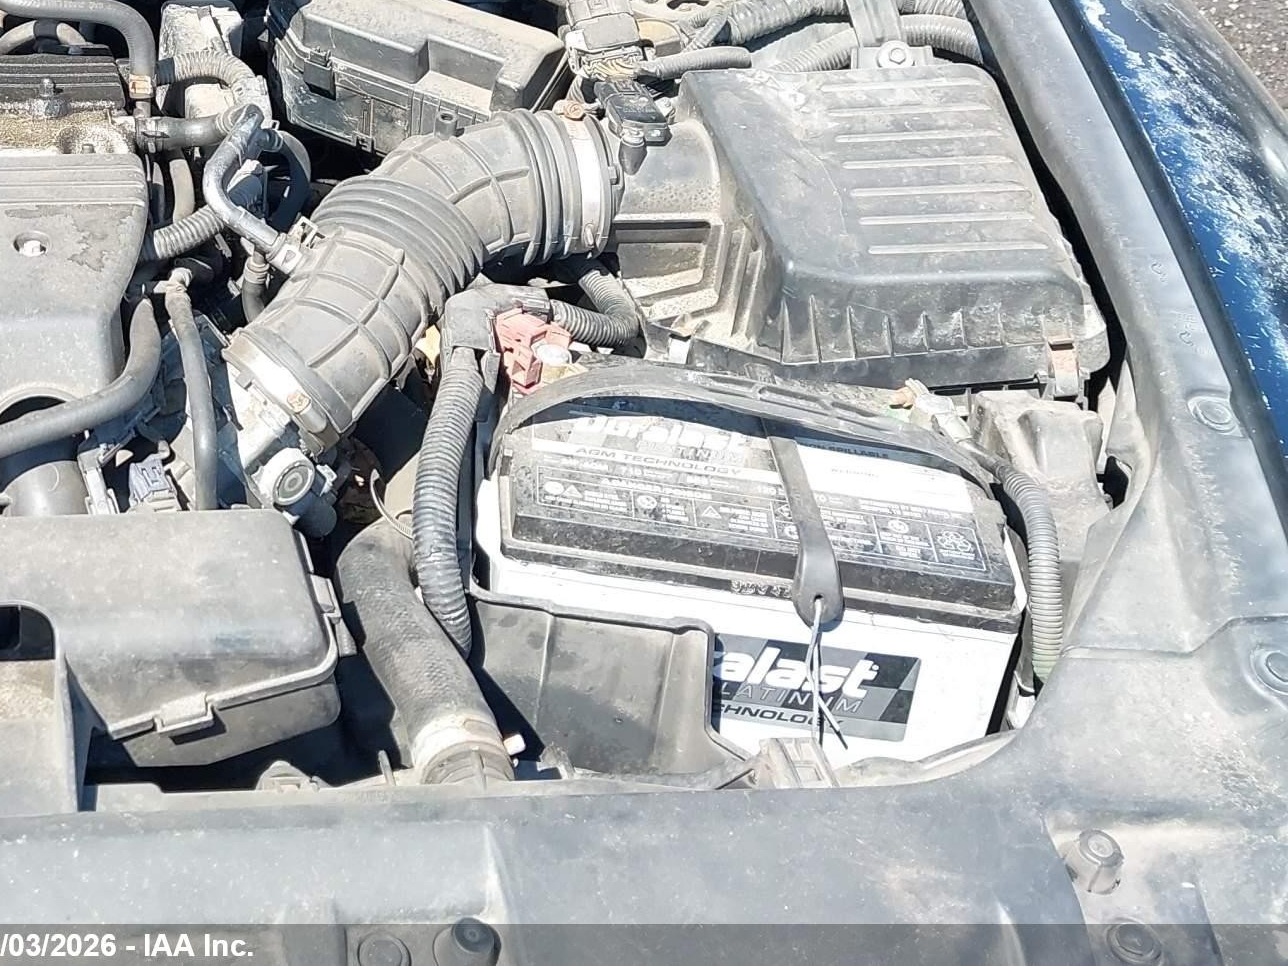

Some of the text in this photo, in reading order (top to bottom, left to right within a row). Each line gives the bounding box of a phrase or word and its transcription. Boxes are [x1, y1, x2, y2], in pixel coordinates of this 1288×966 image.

[576, 446, 616, 459] AGM
[623, 452, 742, 476] TECHNOLOGY
[720, 682, 863, 714] LATINM
